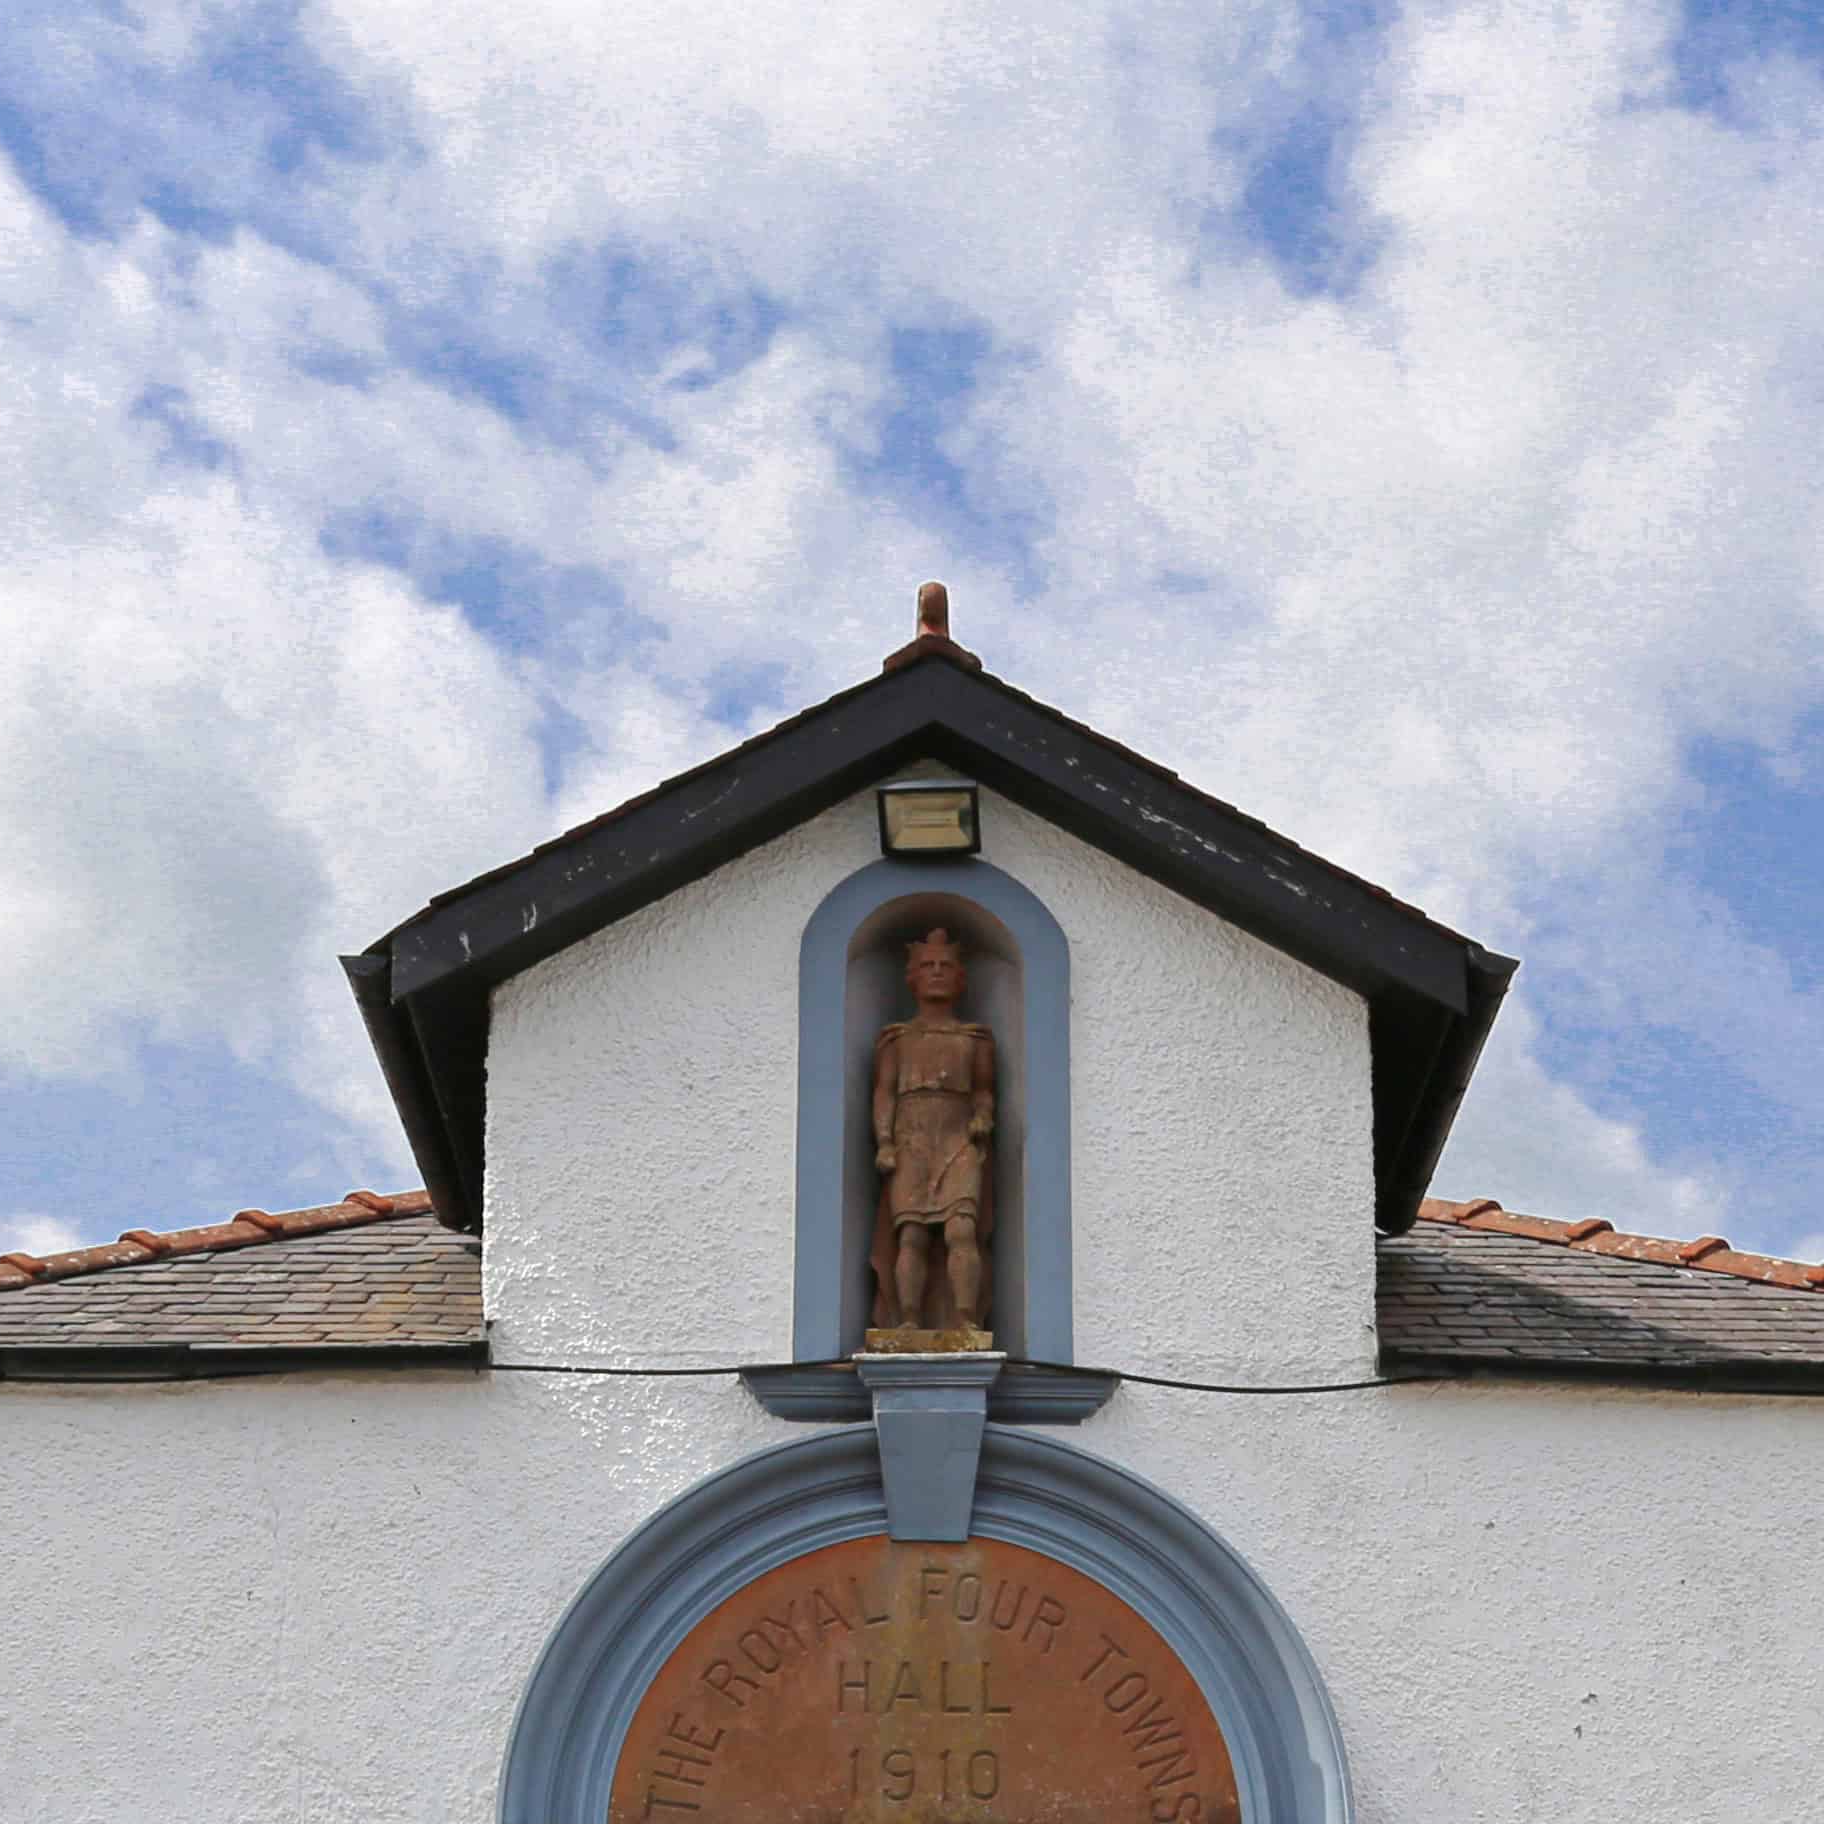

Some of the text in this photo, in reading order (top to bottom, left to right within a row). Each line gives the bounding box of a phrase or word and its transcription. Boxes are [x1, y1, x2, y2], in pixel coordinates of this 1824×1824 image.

[641, 1566, 1202, 1824] THE ROYAL FOUR TOWNS
[836, 1660, 1013, 1715] HALL
[847, 1747, 1000, 1802] 1910
